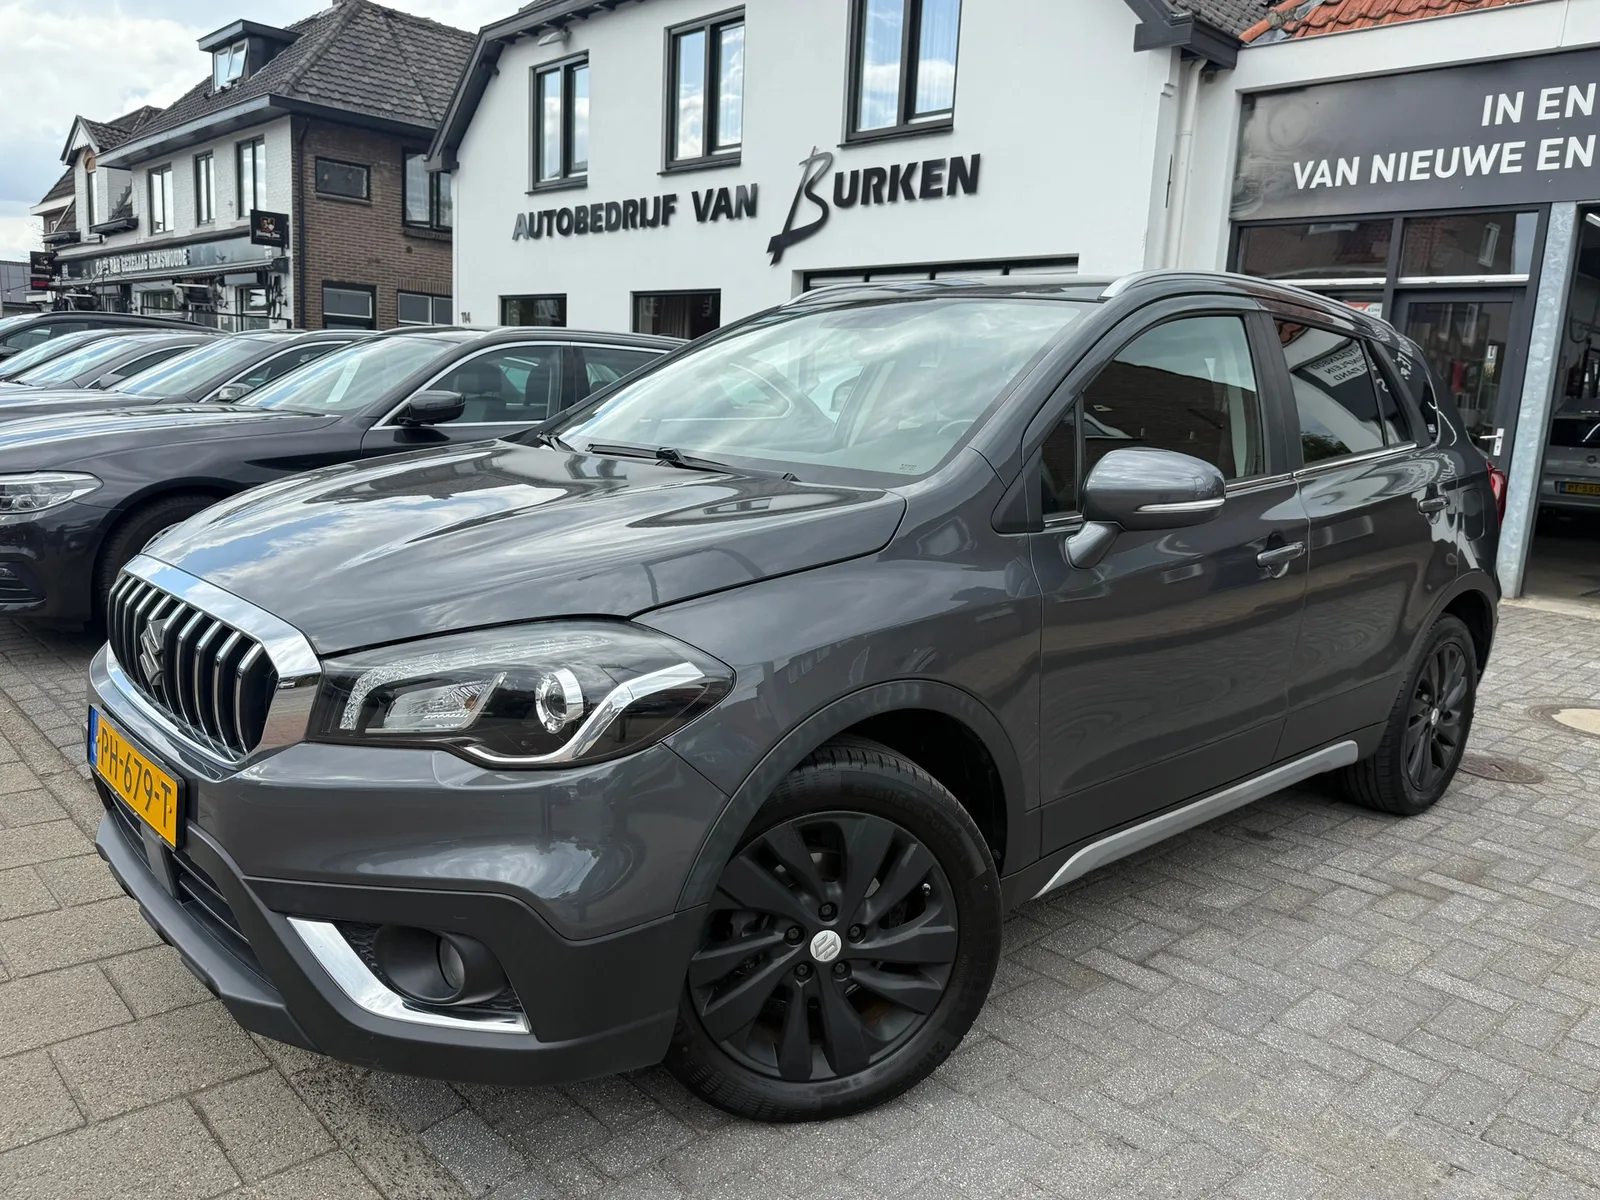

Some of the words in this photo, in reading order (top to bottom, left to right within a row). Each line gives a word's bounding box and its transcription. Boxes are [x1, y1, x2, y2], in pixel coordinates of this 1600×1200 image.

[1481, 91, 1525, 127] IN
[1536, 82, 1597, 121] EN
[1293, 156, 1360, 190] VAN
[1369, 141, 1526, 184] NIEUWE
[1536, 134, 1597, 172] EN
[512, 193, 678, 241] AUTOBEDRIJF
[691, 183, 758, 223] VAN
[766, 145, 981, 266] BURKEN
[101, 725, 172, 830] PH-679-T
